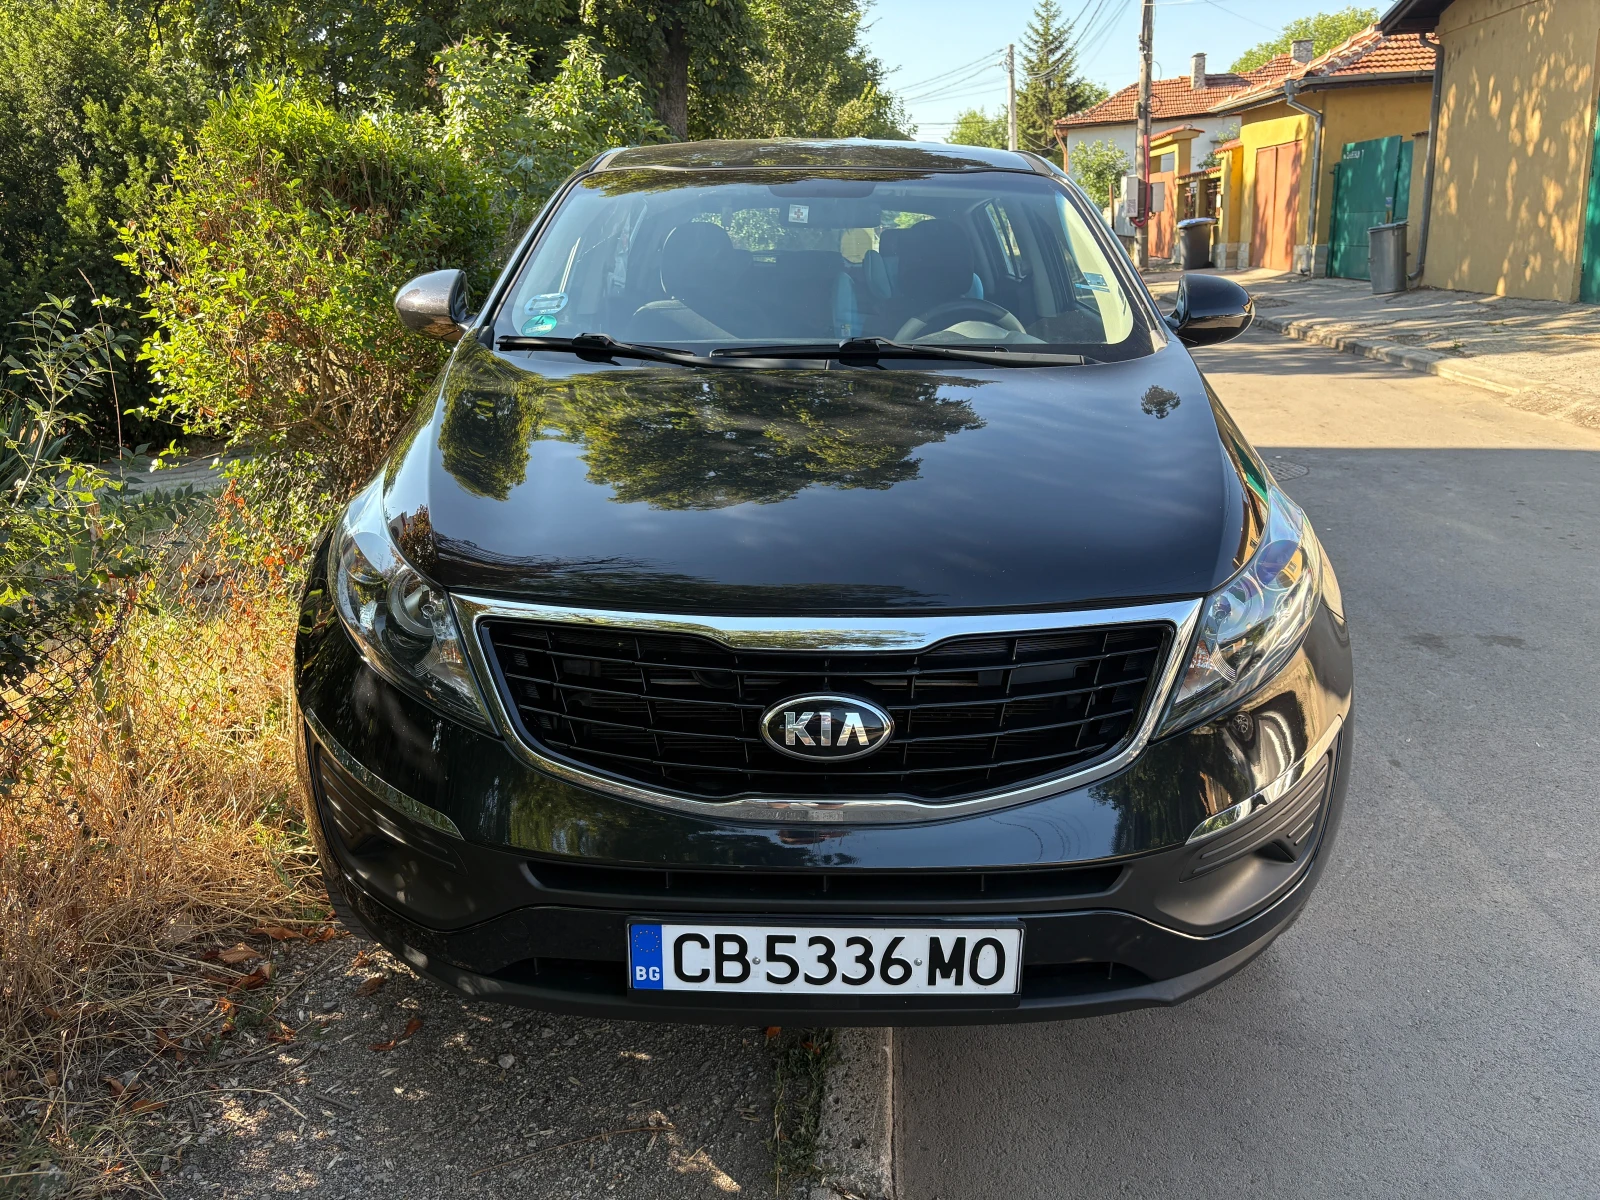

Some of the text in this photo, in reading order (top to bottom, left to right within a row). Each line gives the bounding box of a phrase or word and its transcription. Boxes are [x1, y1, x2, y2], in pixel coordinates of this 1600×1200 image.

[535, 315, 545, 325] 4
[783, 711, 870, 747] KIA
[673, 932, 1006, 987] CB 5336 MO
[635, 966, 660, 981] BG
